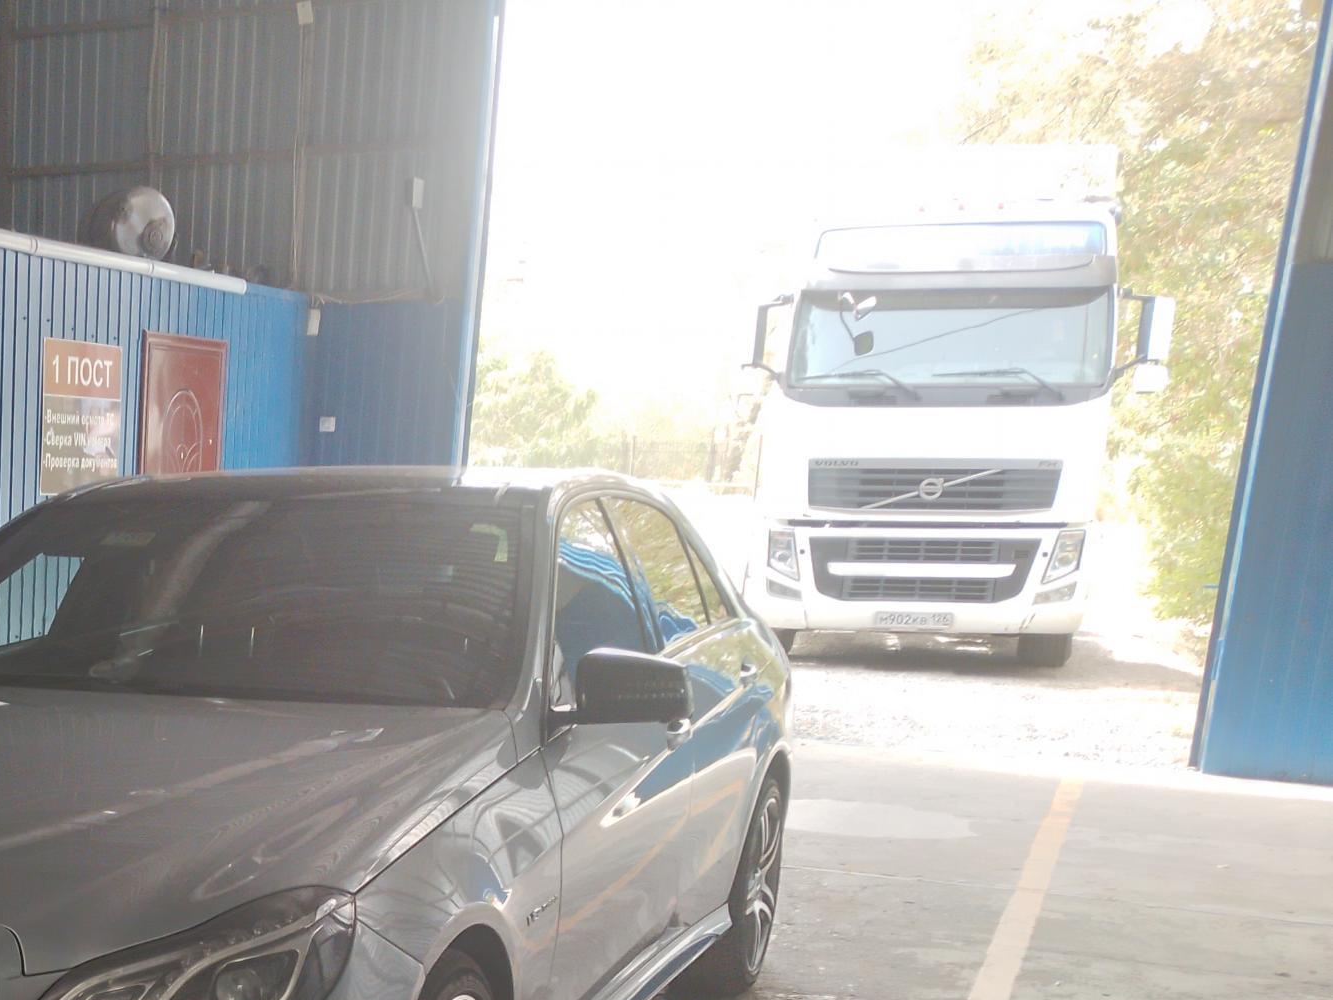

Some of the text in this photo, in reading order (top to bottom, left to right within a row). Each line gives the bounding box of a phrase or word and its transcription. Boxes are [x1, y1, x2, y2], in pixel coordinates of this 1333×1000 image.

[52, 354, 113, 388] 1 ПОСТ
[814, 459, 860, 467] VOLVO
